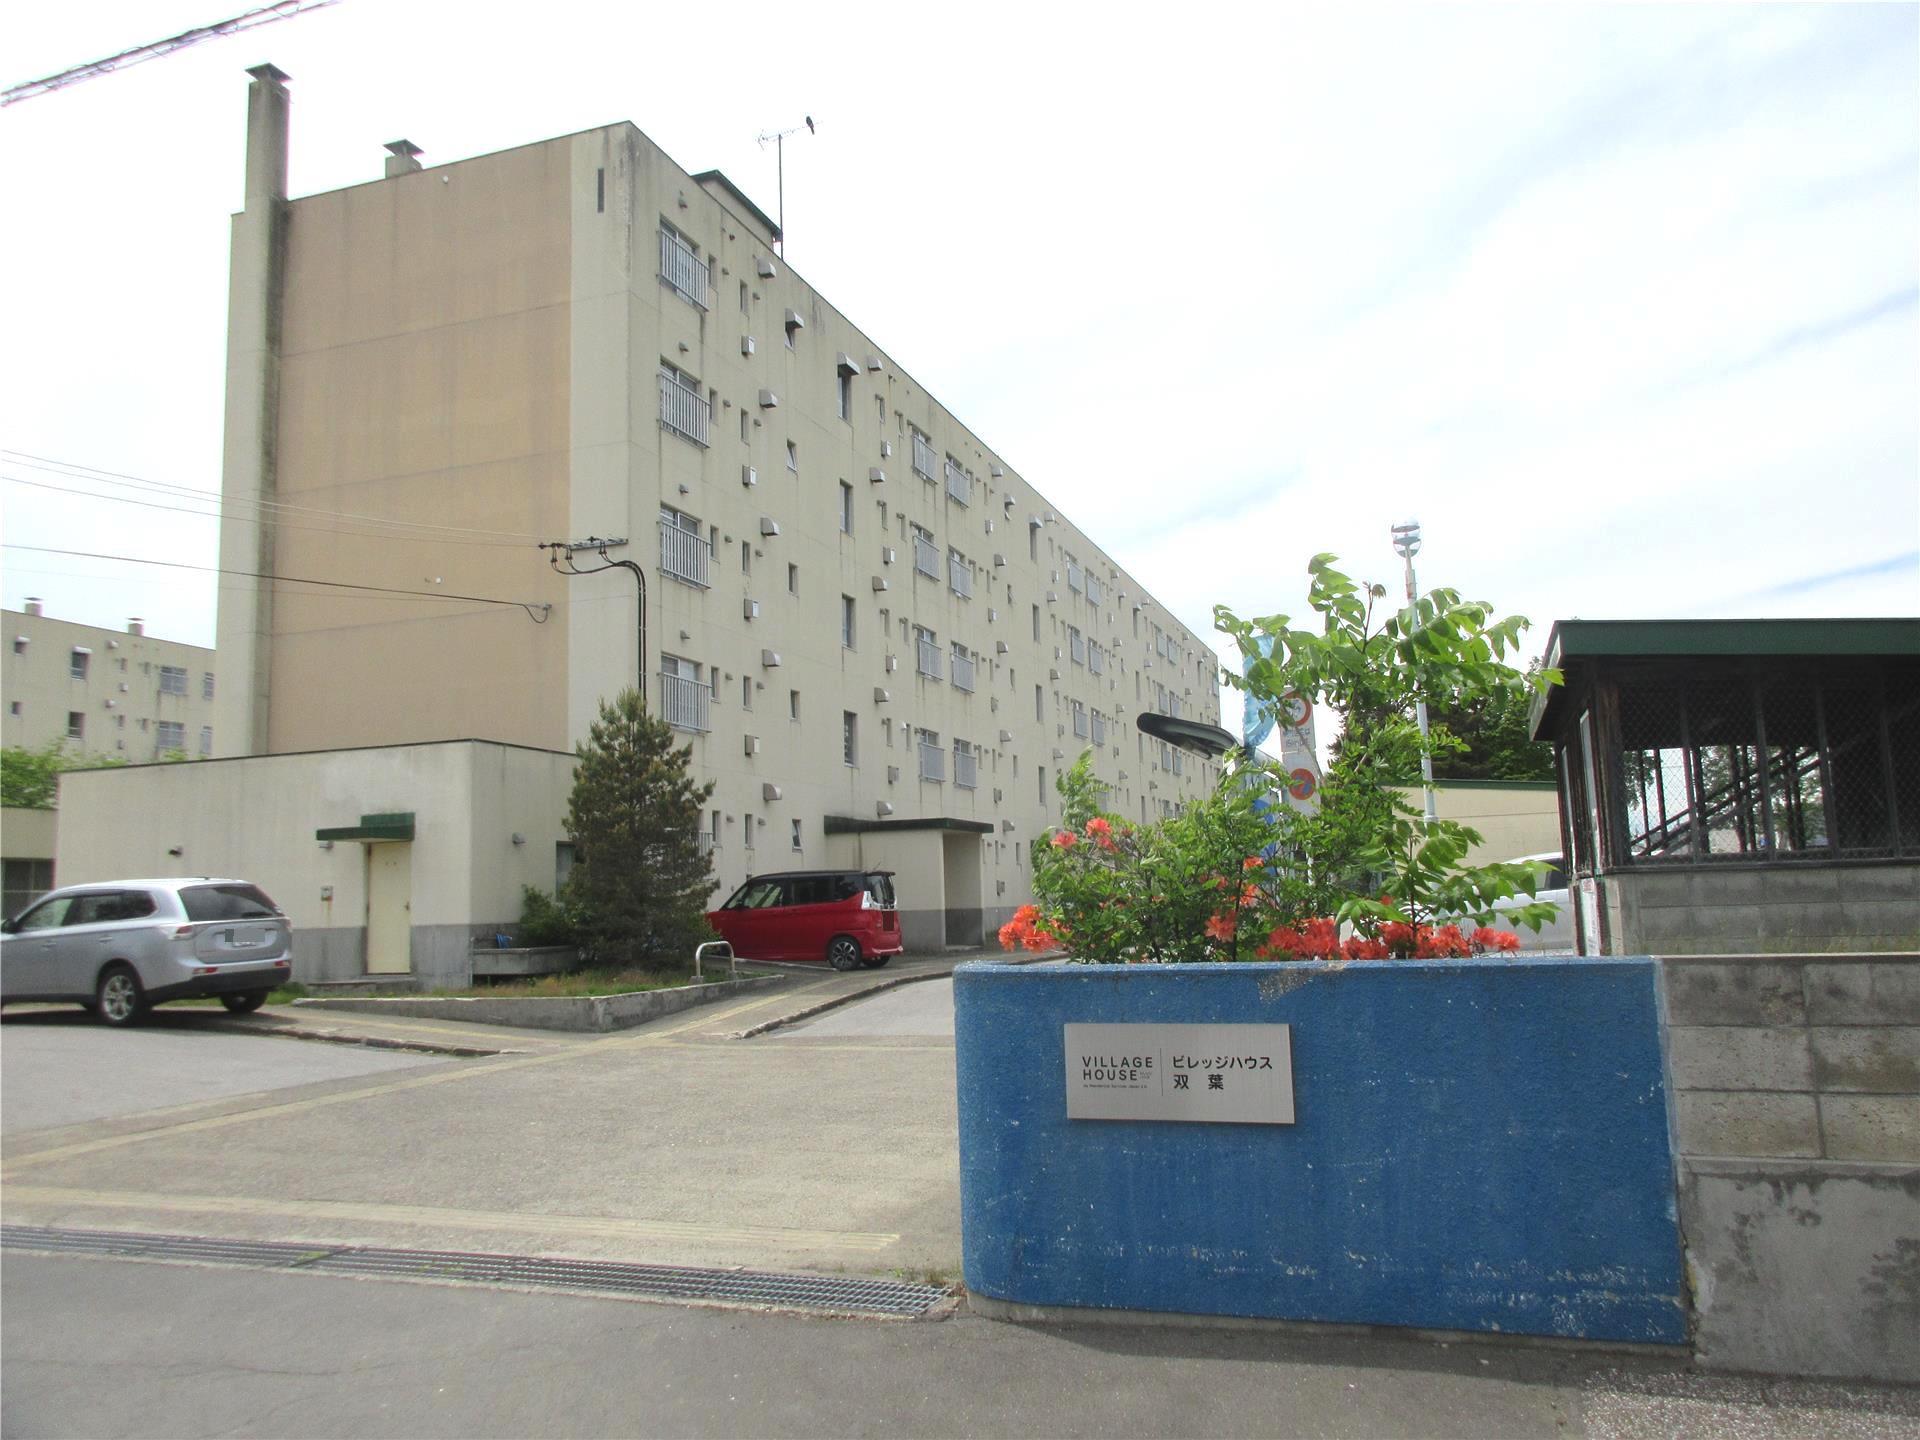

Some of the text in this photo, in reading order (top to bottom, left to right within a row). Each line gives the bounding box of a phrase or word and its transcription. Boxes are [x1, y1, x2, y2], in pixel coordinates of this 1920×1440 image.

[1082, 1056, 1153, 1068] VILLAGE
[1173, 1054, 1273, 1070] ビレッジハウス
[1083, 1069, 1138, 1081] HOUSE
